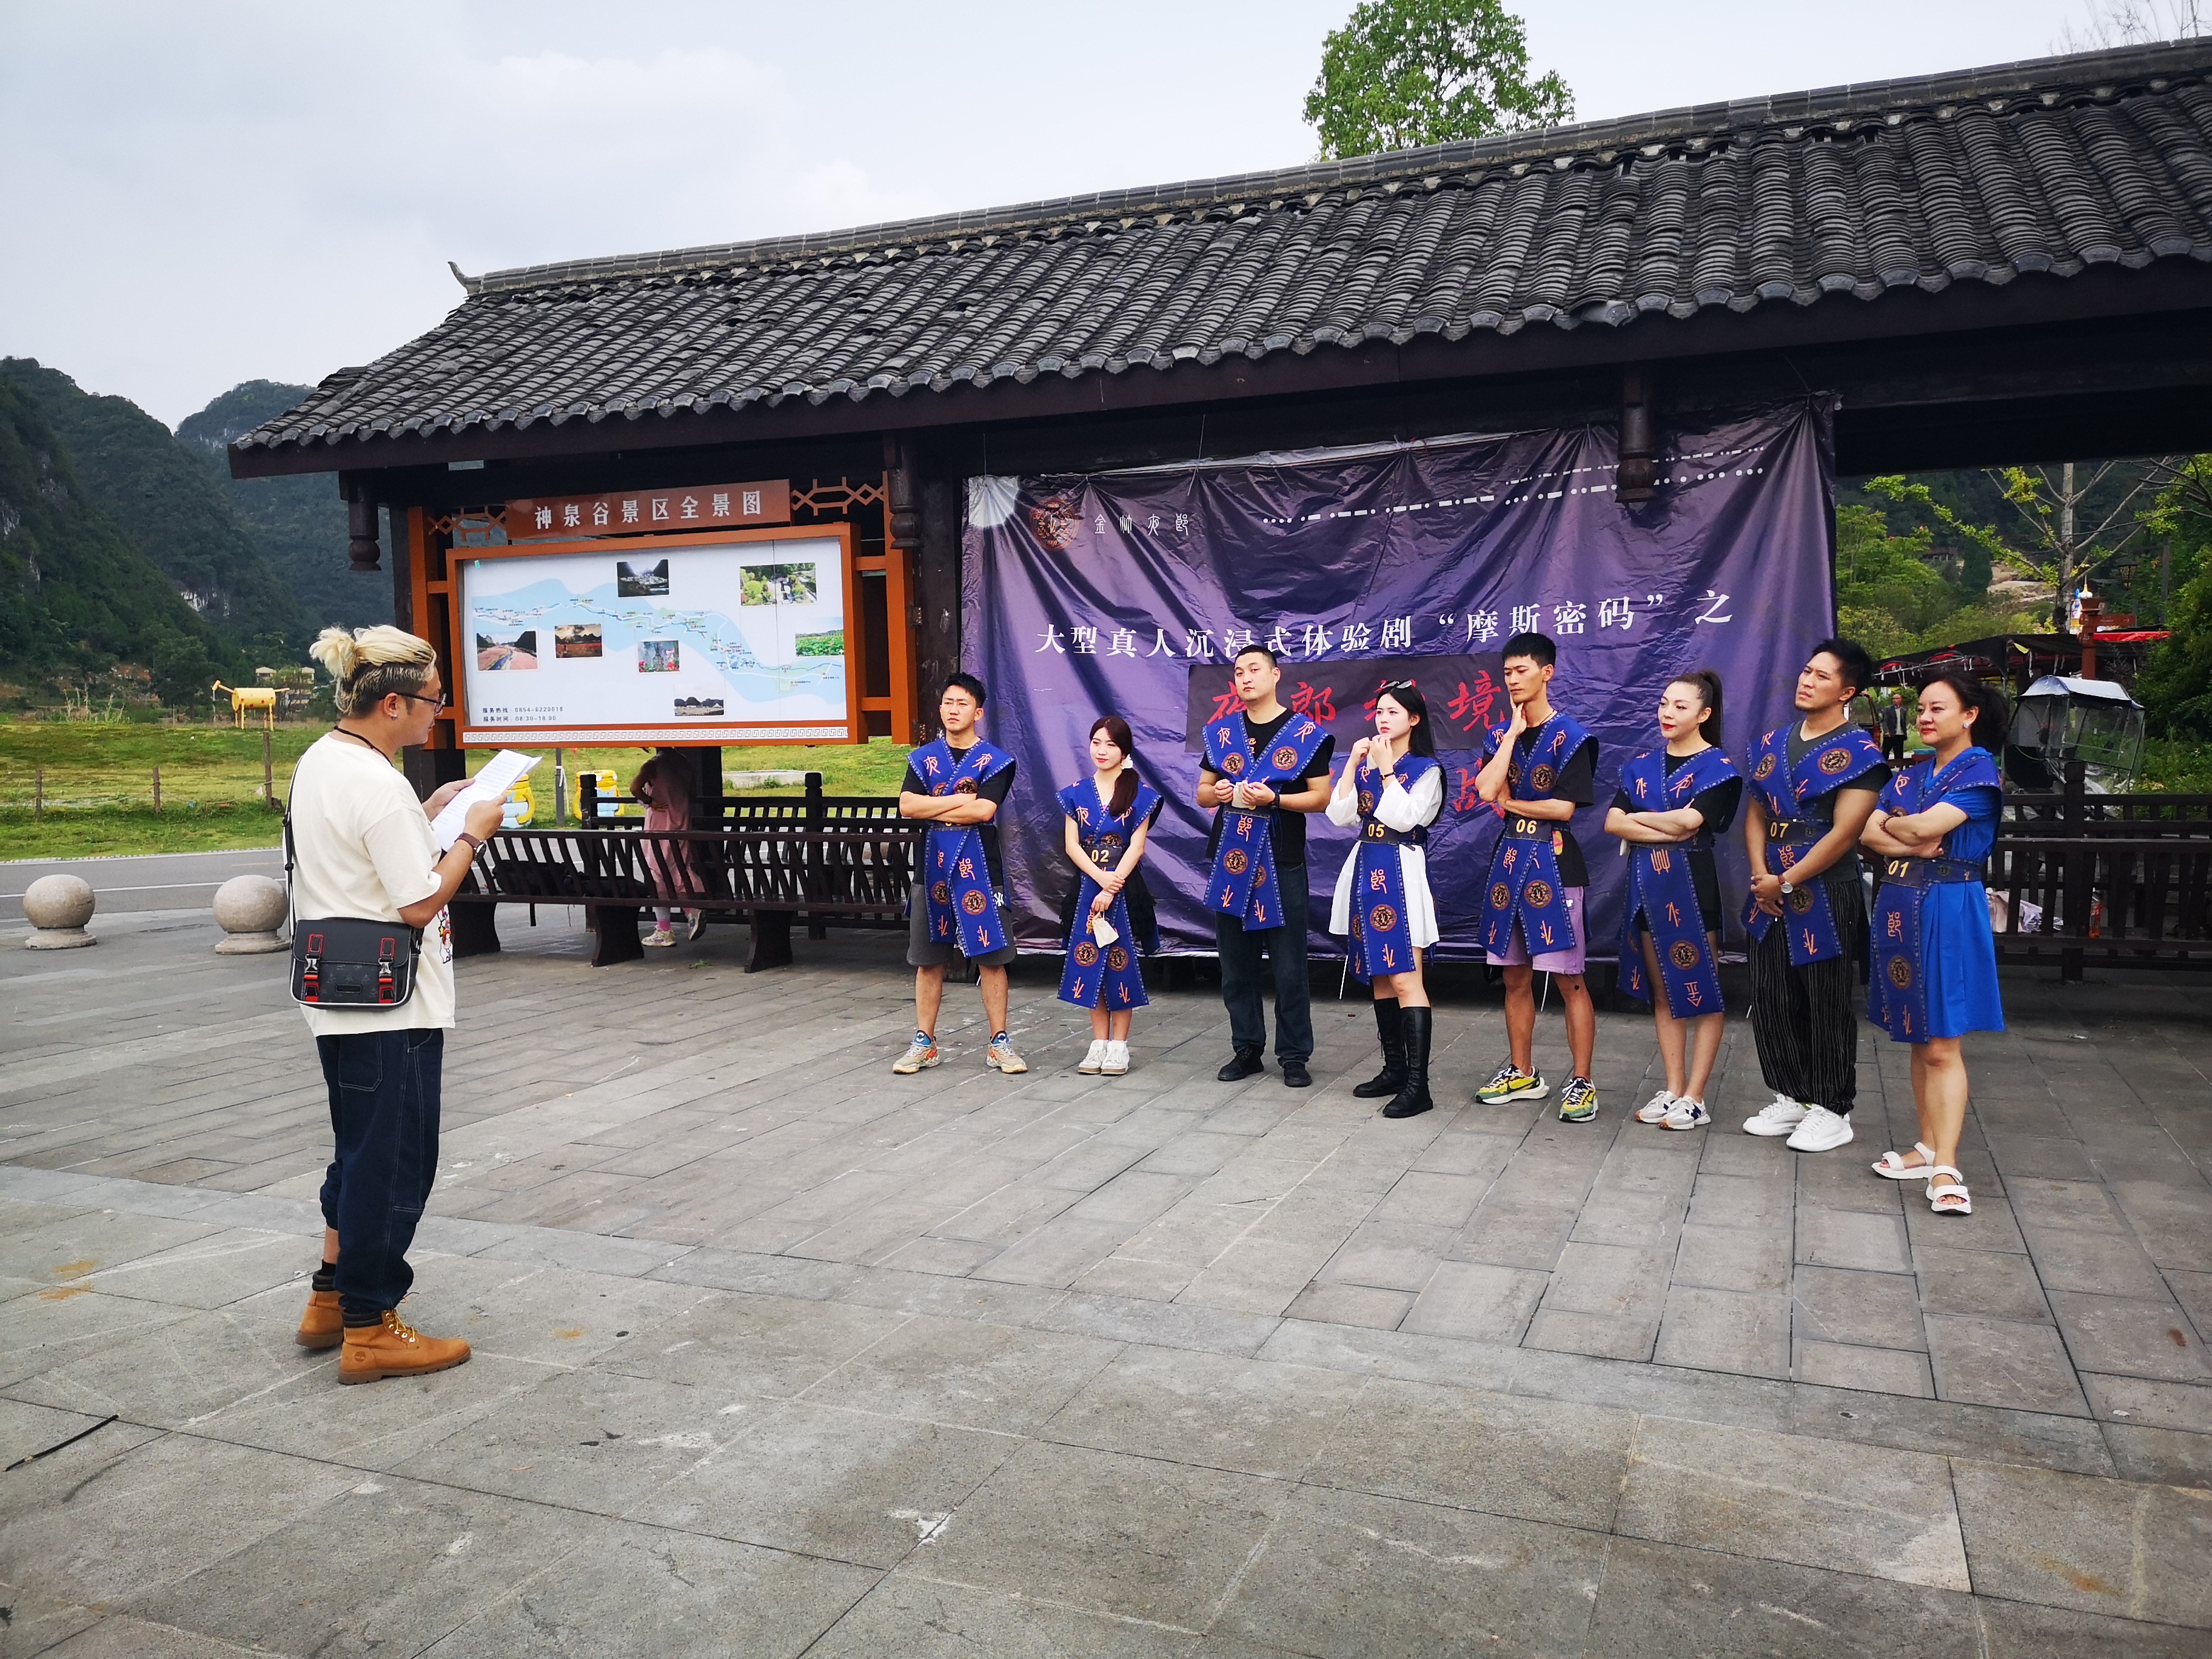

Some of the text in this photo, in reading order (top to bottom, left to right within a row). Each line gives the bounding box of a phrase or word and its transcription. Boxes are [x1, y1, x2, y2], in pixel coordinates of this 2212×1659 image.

[535, 490, 760, 530] 神泉谷景区全景图
[1368, 823, 1385, 838] 05
[1516, 819, 1538, 834] 06
[1770, 822, 1789, 839] 07
[1091, 849, 1110, 863] 02
[1887, 859, 1909, 878] 01
